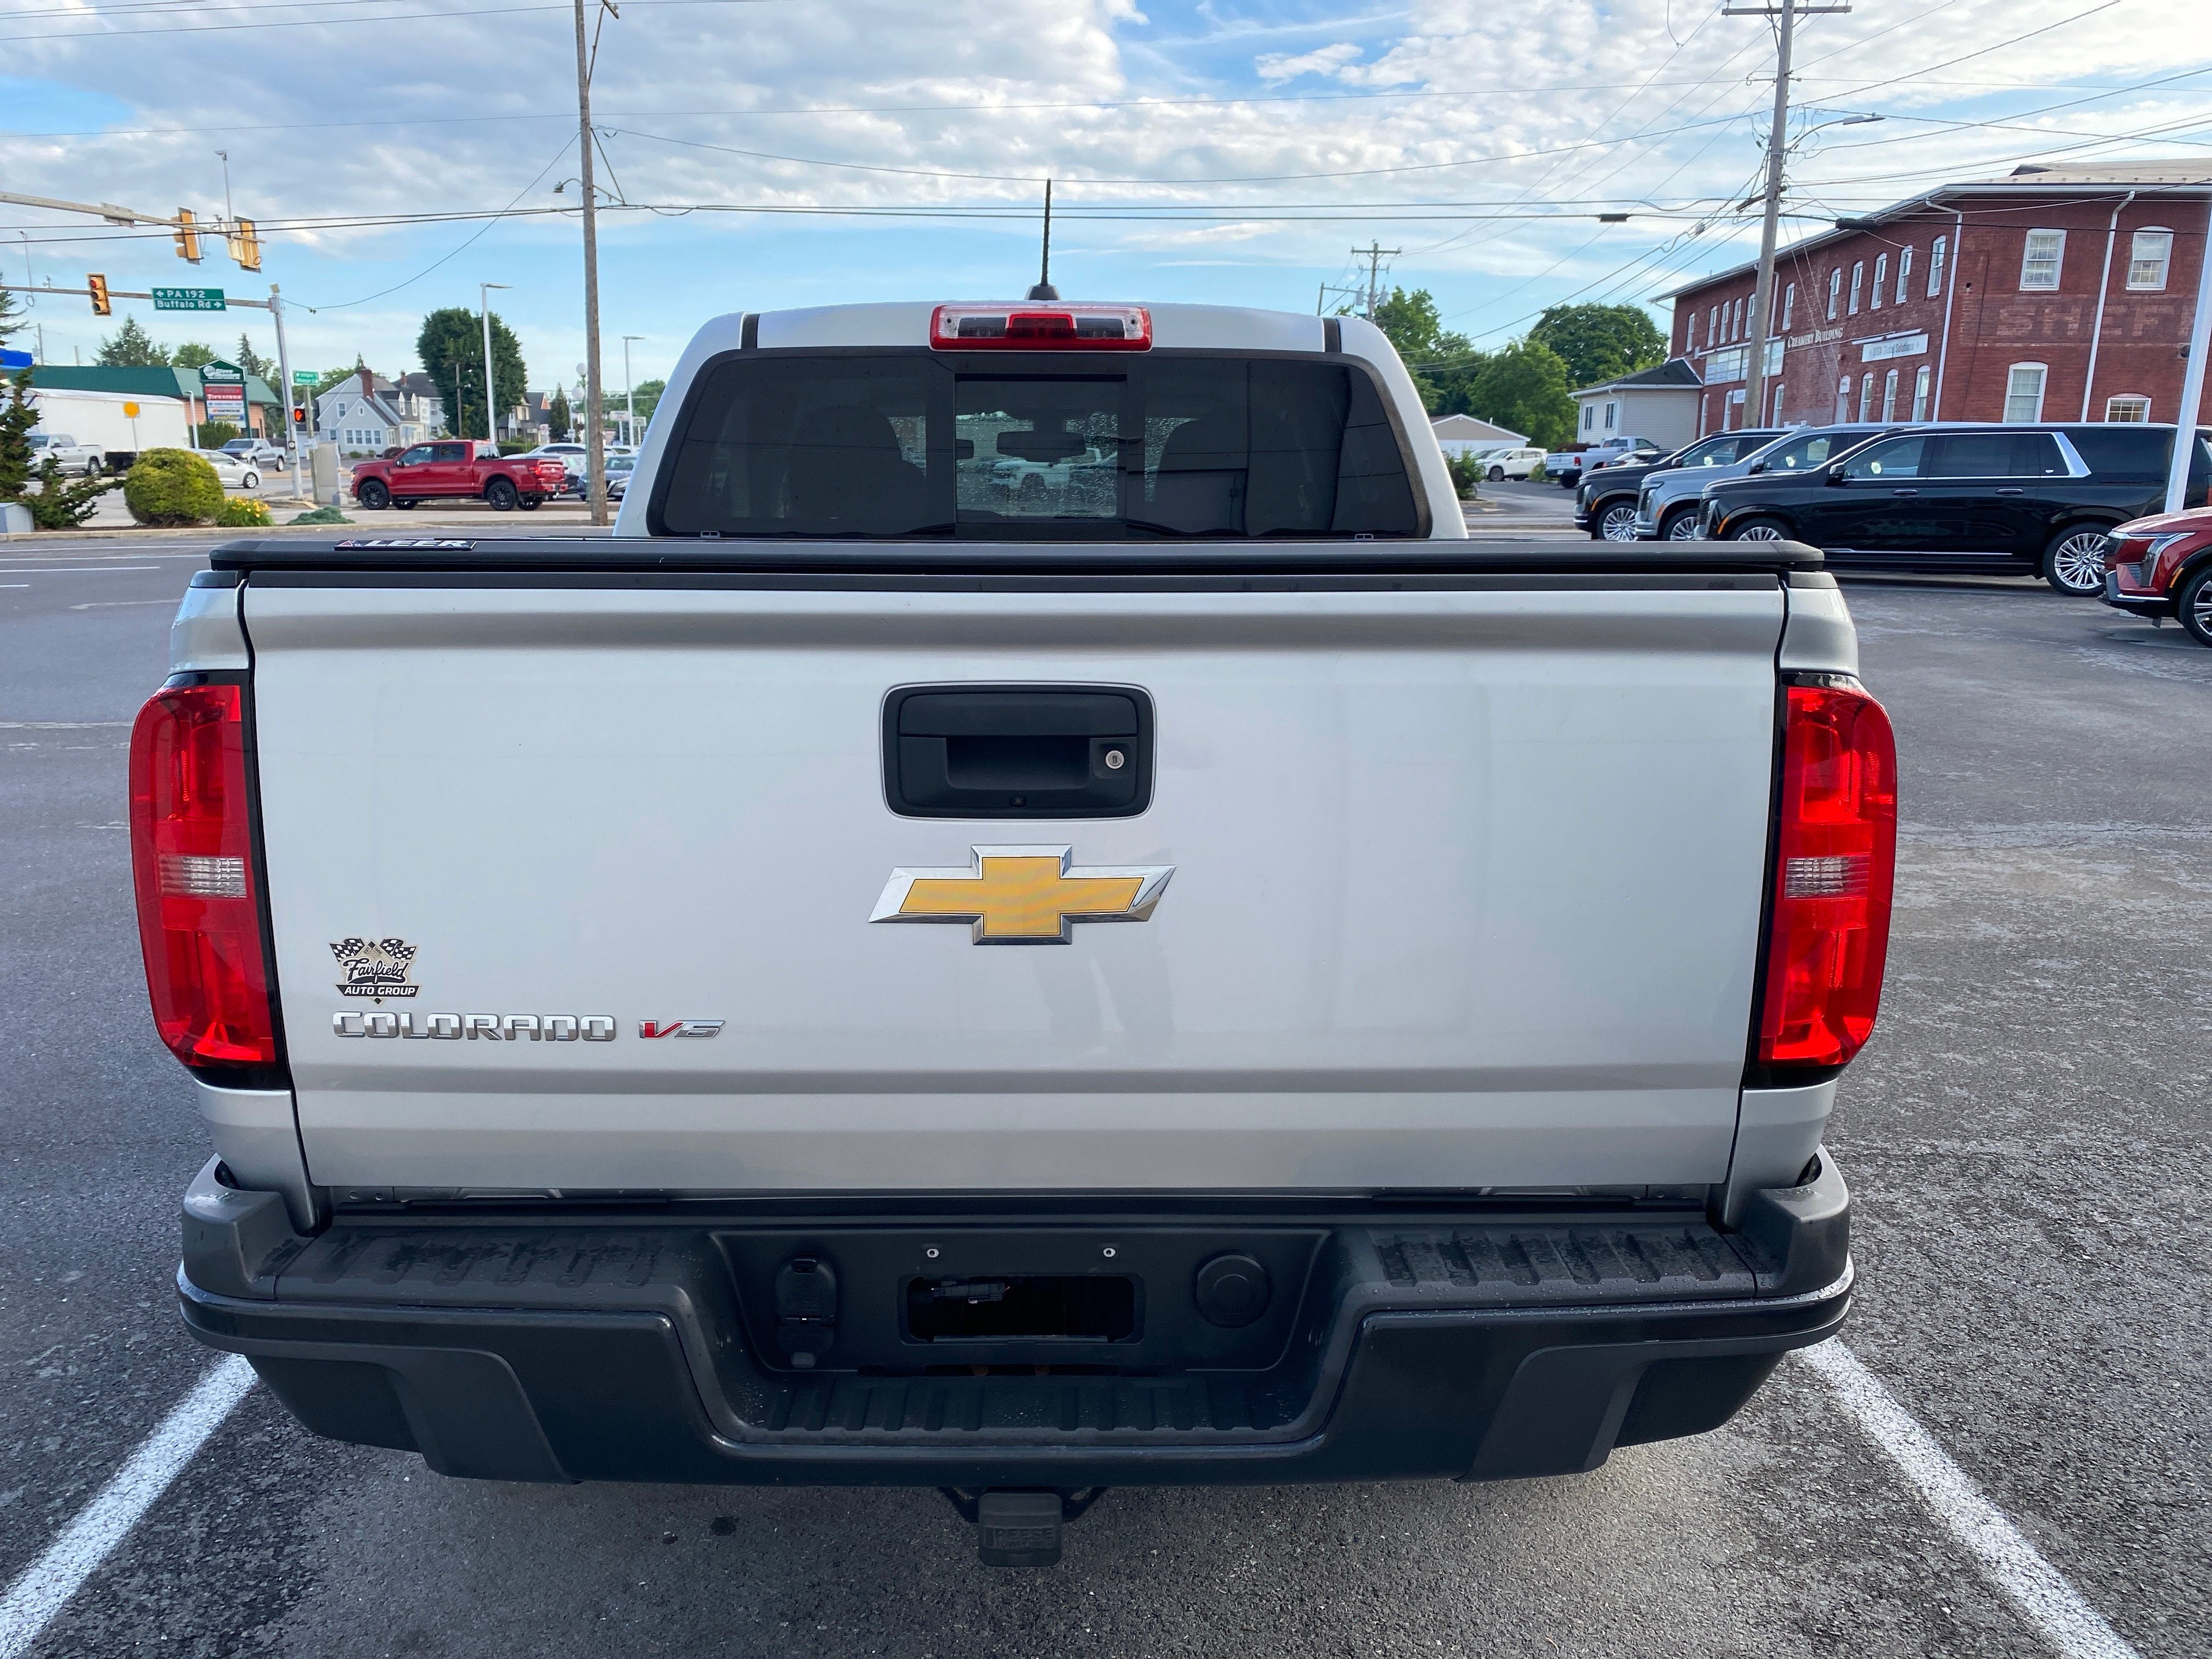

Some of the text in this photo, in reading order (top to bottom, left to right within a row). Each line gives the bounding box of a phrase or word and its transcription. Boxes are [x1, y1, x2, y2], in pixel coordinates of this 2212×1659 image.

[166, 290, 183, 298] PA
[157, 300, 211, 308] Buffalo Rd
[342, 957, 409, 984] Fairfield
[345, 986, 415, 996] AUTO GROUP
[332, 1011, 616, 1041] COLORADO
[639, 1019, 725, 1040] V6
[994, 1527, 1054, 1539] REESE
